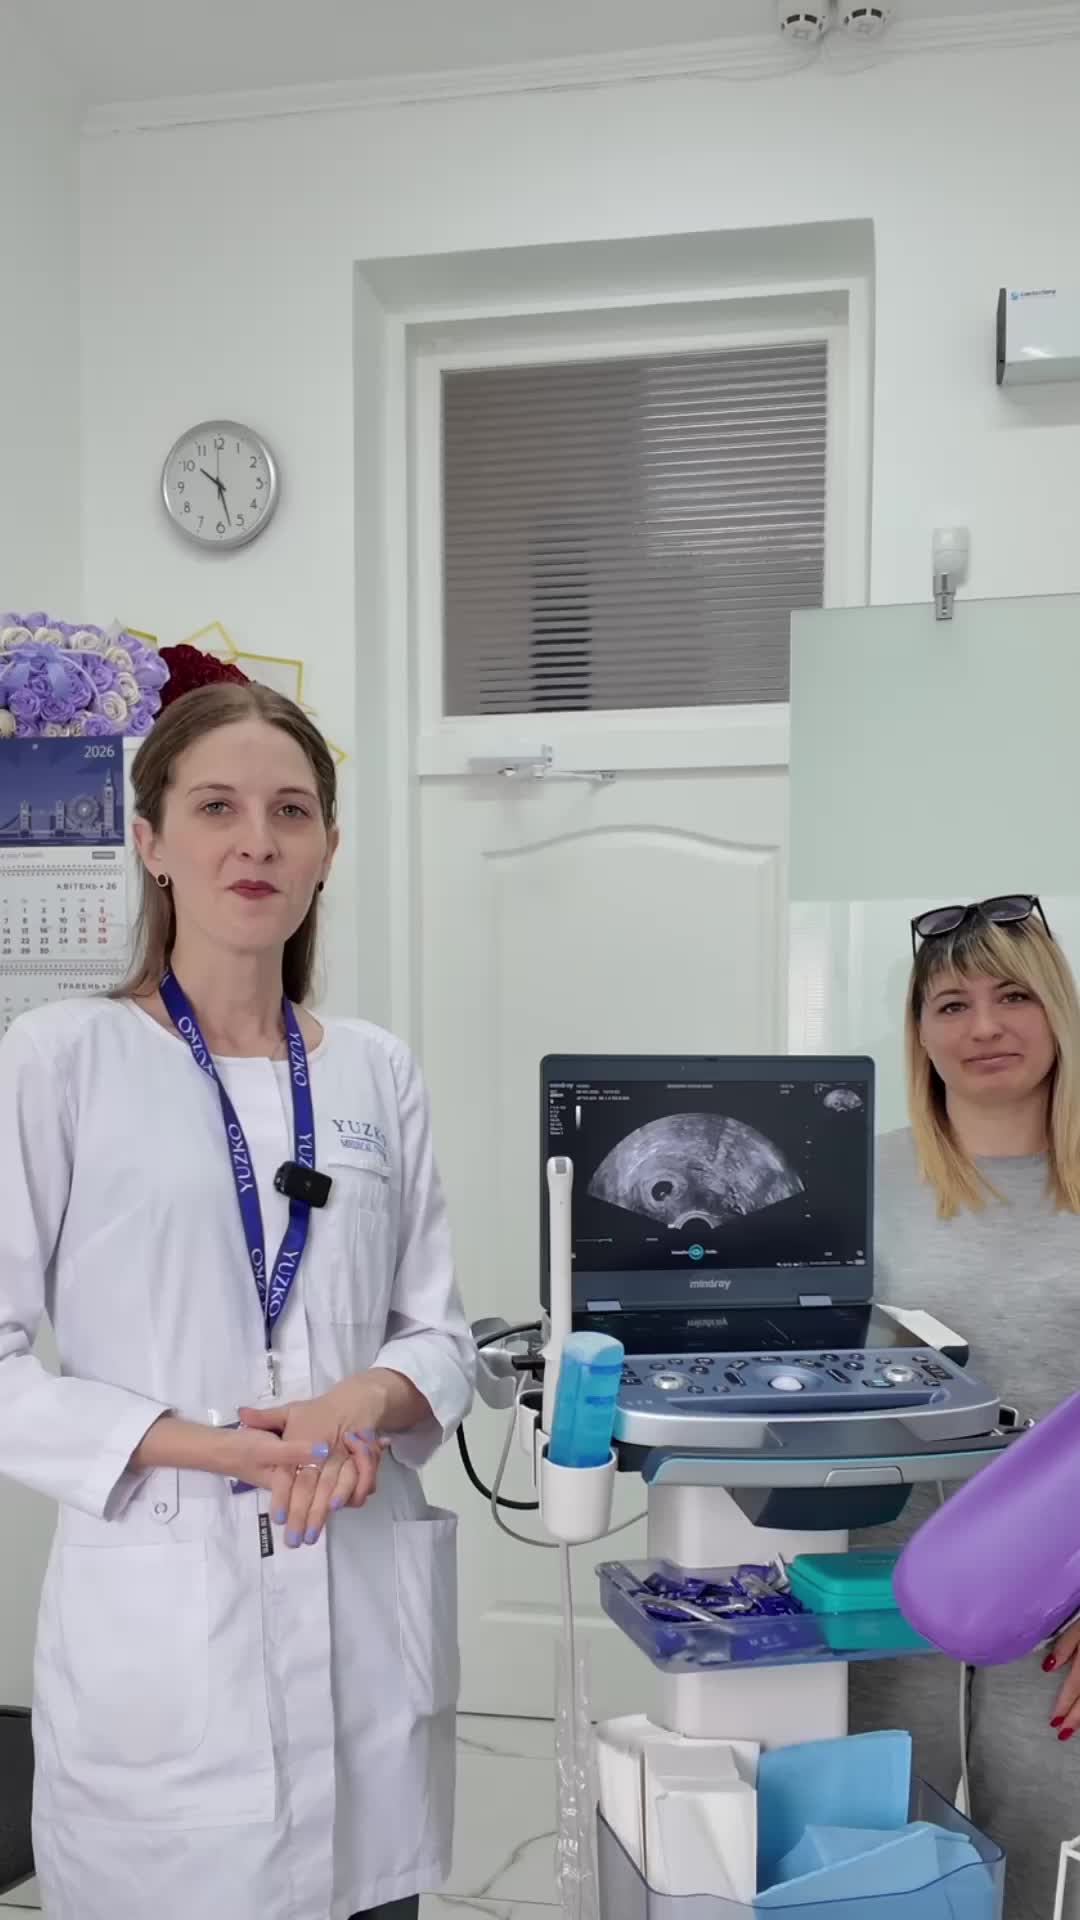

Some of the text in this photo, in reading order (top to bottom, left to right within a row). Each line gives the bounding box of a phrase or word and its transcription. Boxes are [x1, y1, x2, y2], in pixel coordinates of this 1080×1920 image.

[213, 437, 225, 450] 12
[198, 445, 207, 456] 11
[183, 460, 196, 472] 10
[249, 456, 257, 468] 2
[177, 481, 185, 494] 9
[256, 477, 264, 489] 3
[183, 501, 191, 513] 8
[249, 498, 257, 509] 4
[198, 516, 205, 528] 7
[235, 514, 245, 526] 5
[215, 521, 226, 534] 6
[84, 745, 115, 758] 2026
[177, 1015, 215, 1077] YUZKO
[289, 1032, 308, 1087] YUZKO
[297, 1132, 313, 1169] YUZ
[227, 1123, 254, 1193] YUZKO
[268, 1250, 300, 1318] YUZKO
[689, 1279, 731, 1290] mindray
